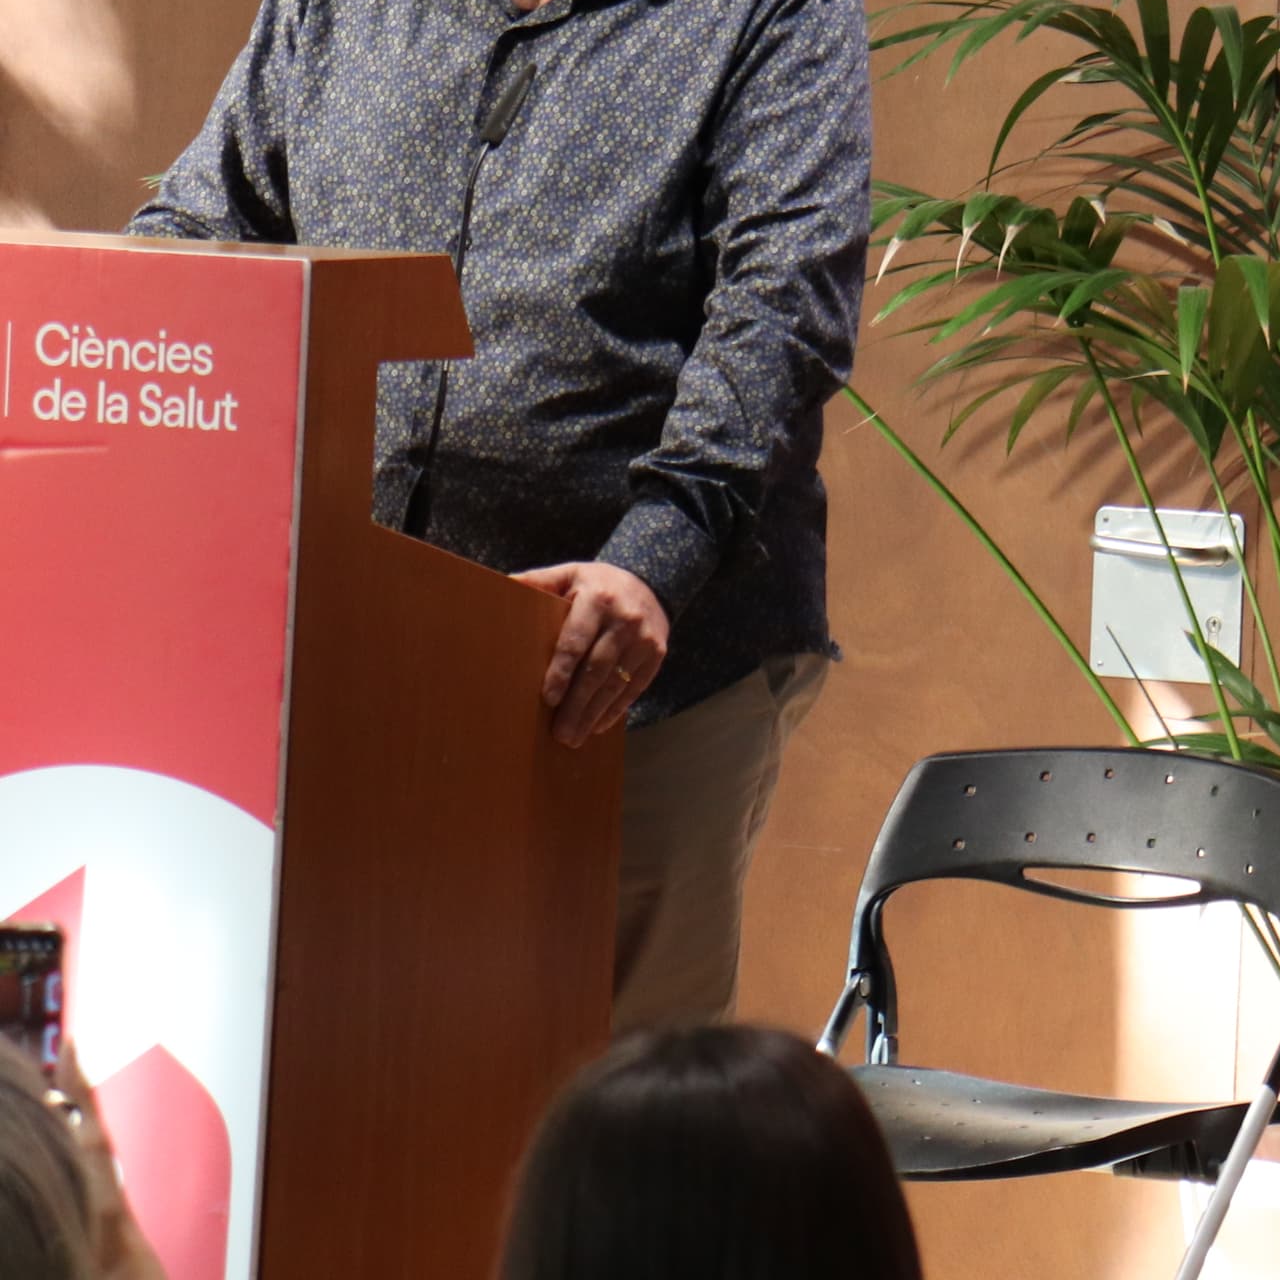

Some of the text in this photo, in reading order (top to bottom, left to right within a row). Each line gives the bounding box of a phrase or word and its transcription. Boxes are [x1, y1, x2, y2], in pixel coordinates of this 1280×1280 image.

[34, 322, 214, 376] Ciències
[32, 378, 239, 432] de la Salut
